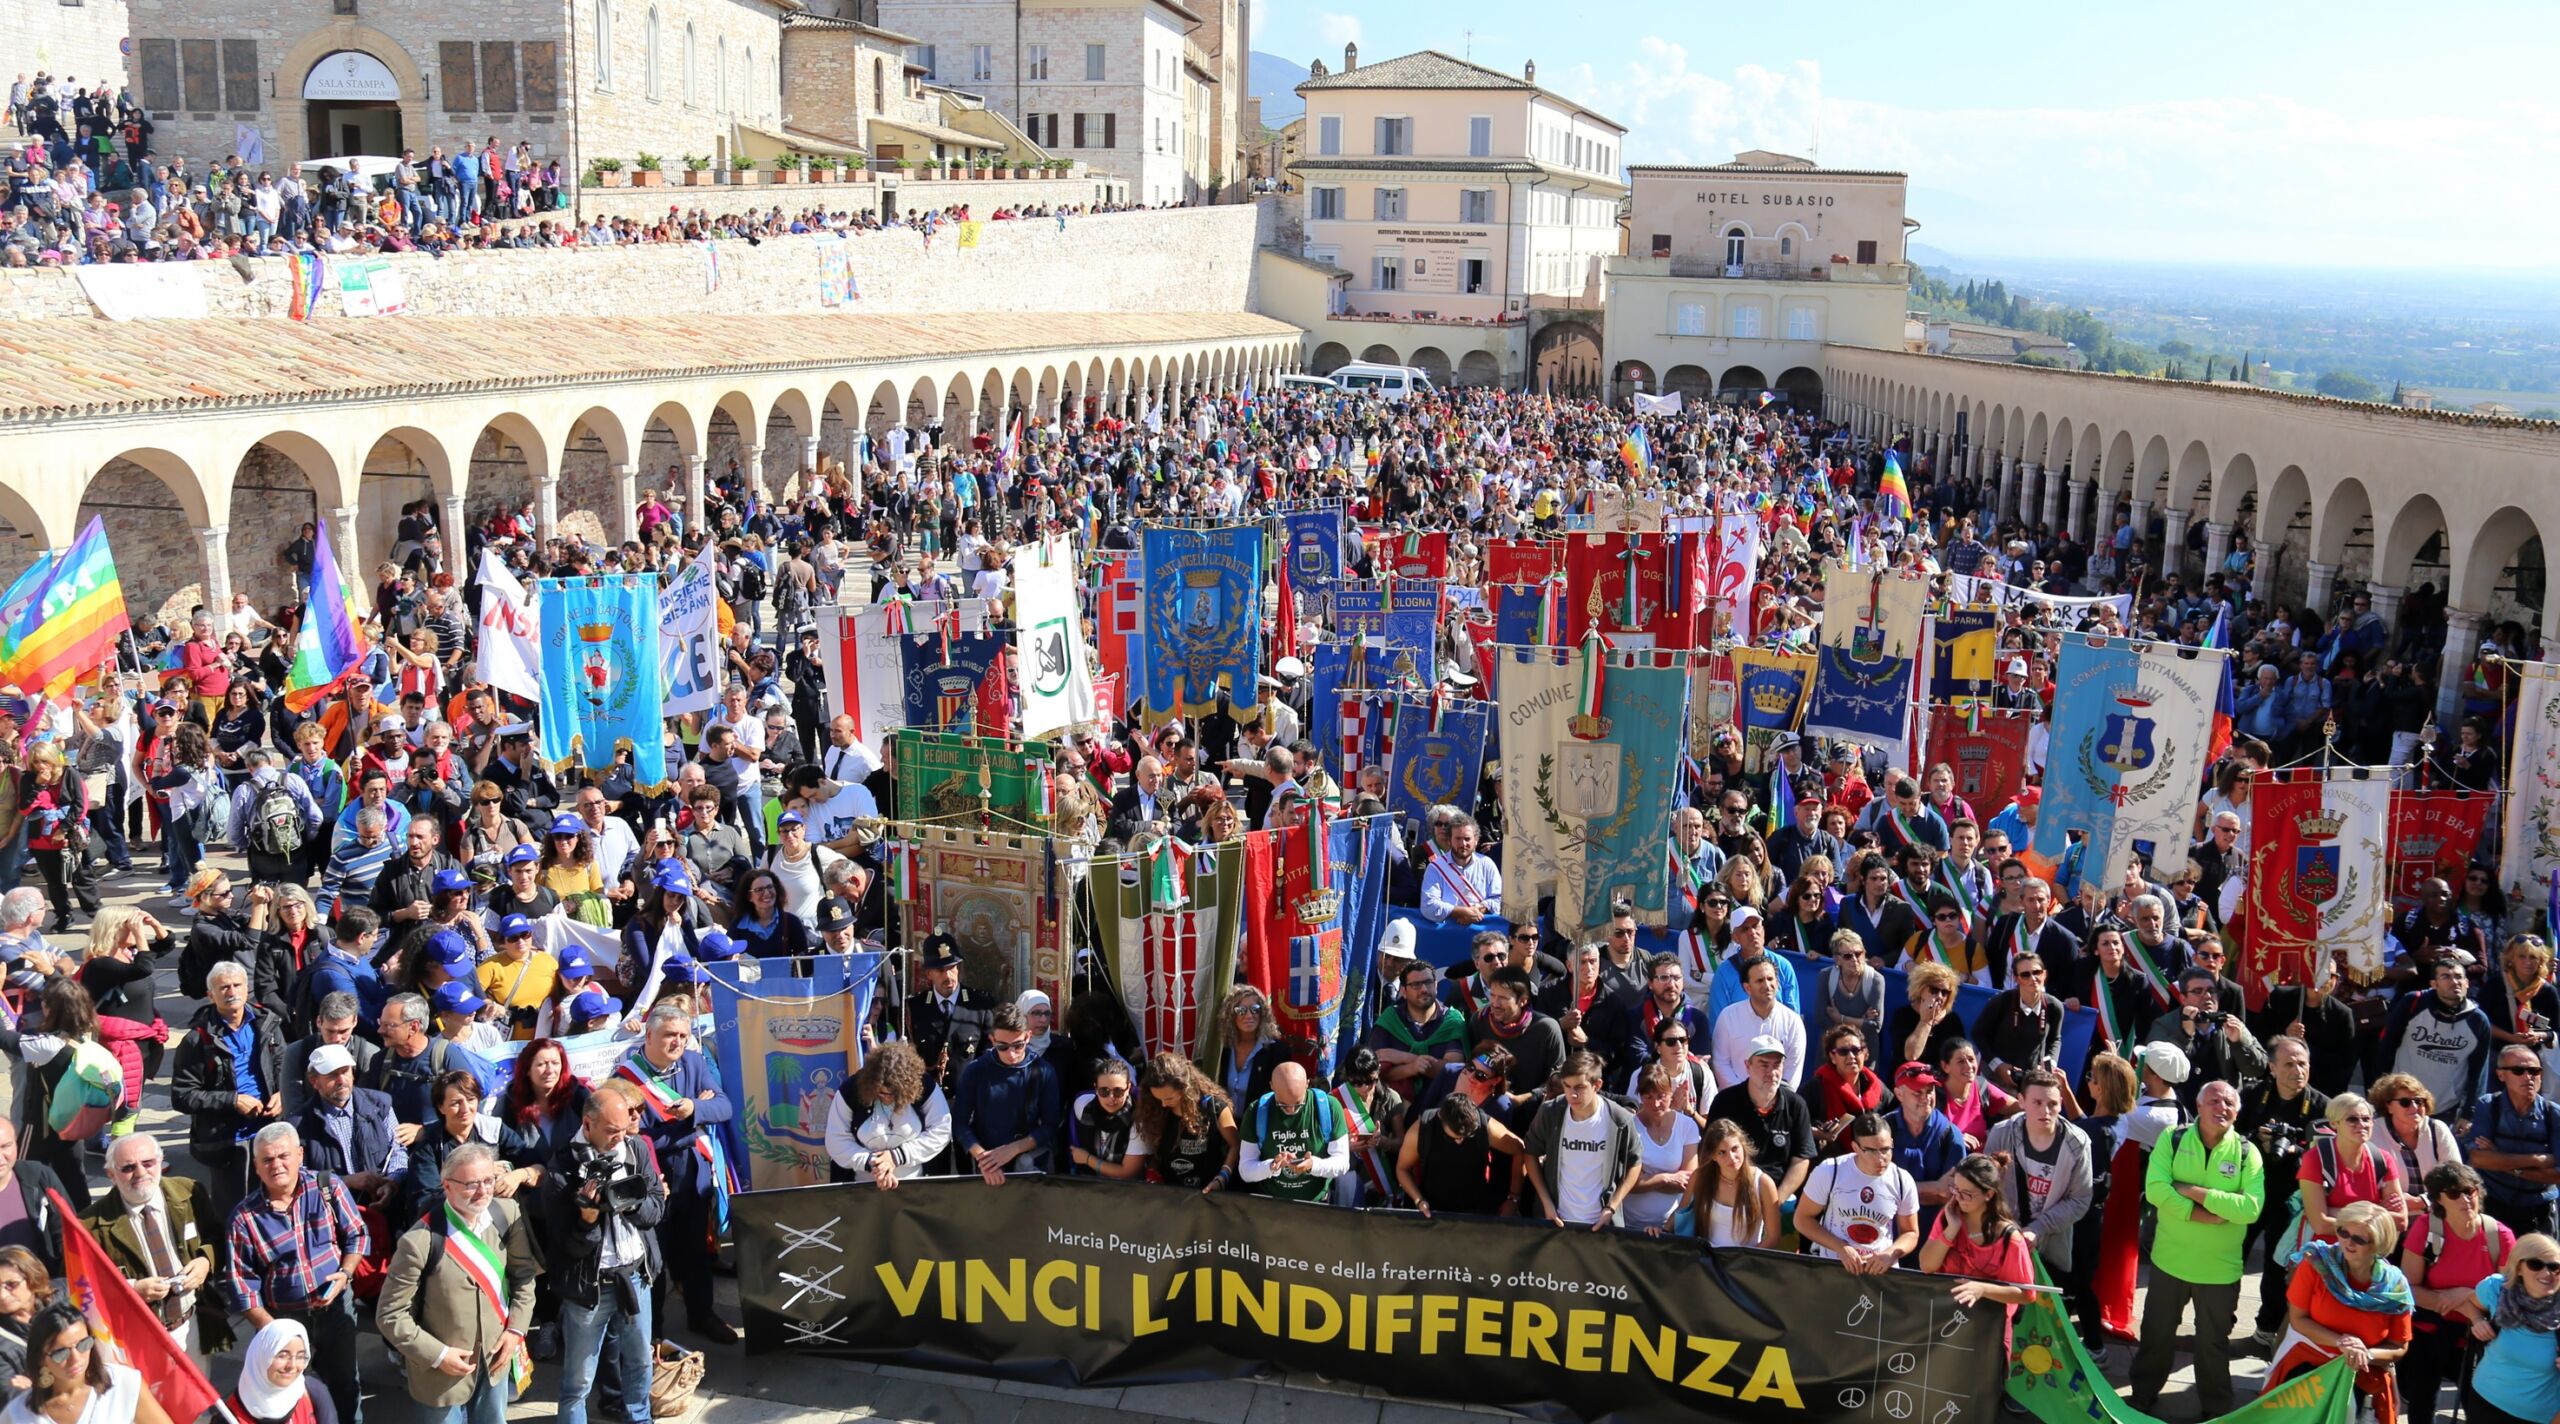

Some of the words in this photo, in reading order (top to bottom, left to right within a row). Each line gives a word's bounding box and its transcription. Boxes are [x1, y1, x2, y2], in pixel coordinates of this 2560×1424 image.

[318, 80, 343, 88] SALA
[346, 80, 386, 89] STAMPA
[1697, 193, 1749, 204] HOTEL
[1762, 194, 1834, 207] SUBASIO
[660, 574, 710, 609] INSIEME
[1340, 597, 1370, 607] CITTA'
[1394, 597, 1432, 607] OLOGNA
[585, 607, 594, 616] DI
[1954, 616, 1983, 625] PARMA
[2128, 658, 2202, 703] GROTTAMMARE
[1509, 682, 1575, 727] COMUNE
[924, 749, 960, 764] REGIONE
[2268, 792, 2297, 819] CITTA'
[2304, 788, 2315, 800] DI
[2426, 811, 2440, 822] DI
[2445, 815, 2475, 839] BRA
[2411, 1026, 2466, 1049] Detroit
[1272, 1130, 1296, 1142] Figlio
[1300, 1129, 1309, 1138] di
[2030, 1178, 2049, 1193] ATE
[1839, 1207, 1858, 1217] JACK
[1048, 1227, 1104, 1249] Marcia
[1109, 1234, 1212, 1264] PerugiAssisi
[1218, 1240, 1259, 1262] della
[1265, 1253, 1309, 1270] pace
[1314, 1261, 1326, 1274] e
[1331, 1261, 1376, 1280] della
[1382, 1262, 1472, 1283] fraternità
[1490, 1273, 1501, 1287] 9
[1507, 1272, 1579, 1294] ottobre
[1584, 1280, 1628, 1300] 2016
[874, 1258, 1100, 1331] VINCI
[1133, 1267, 1805, 1409] L'INDIFFERENZA
